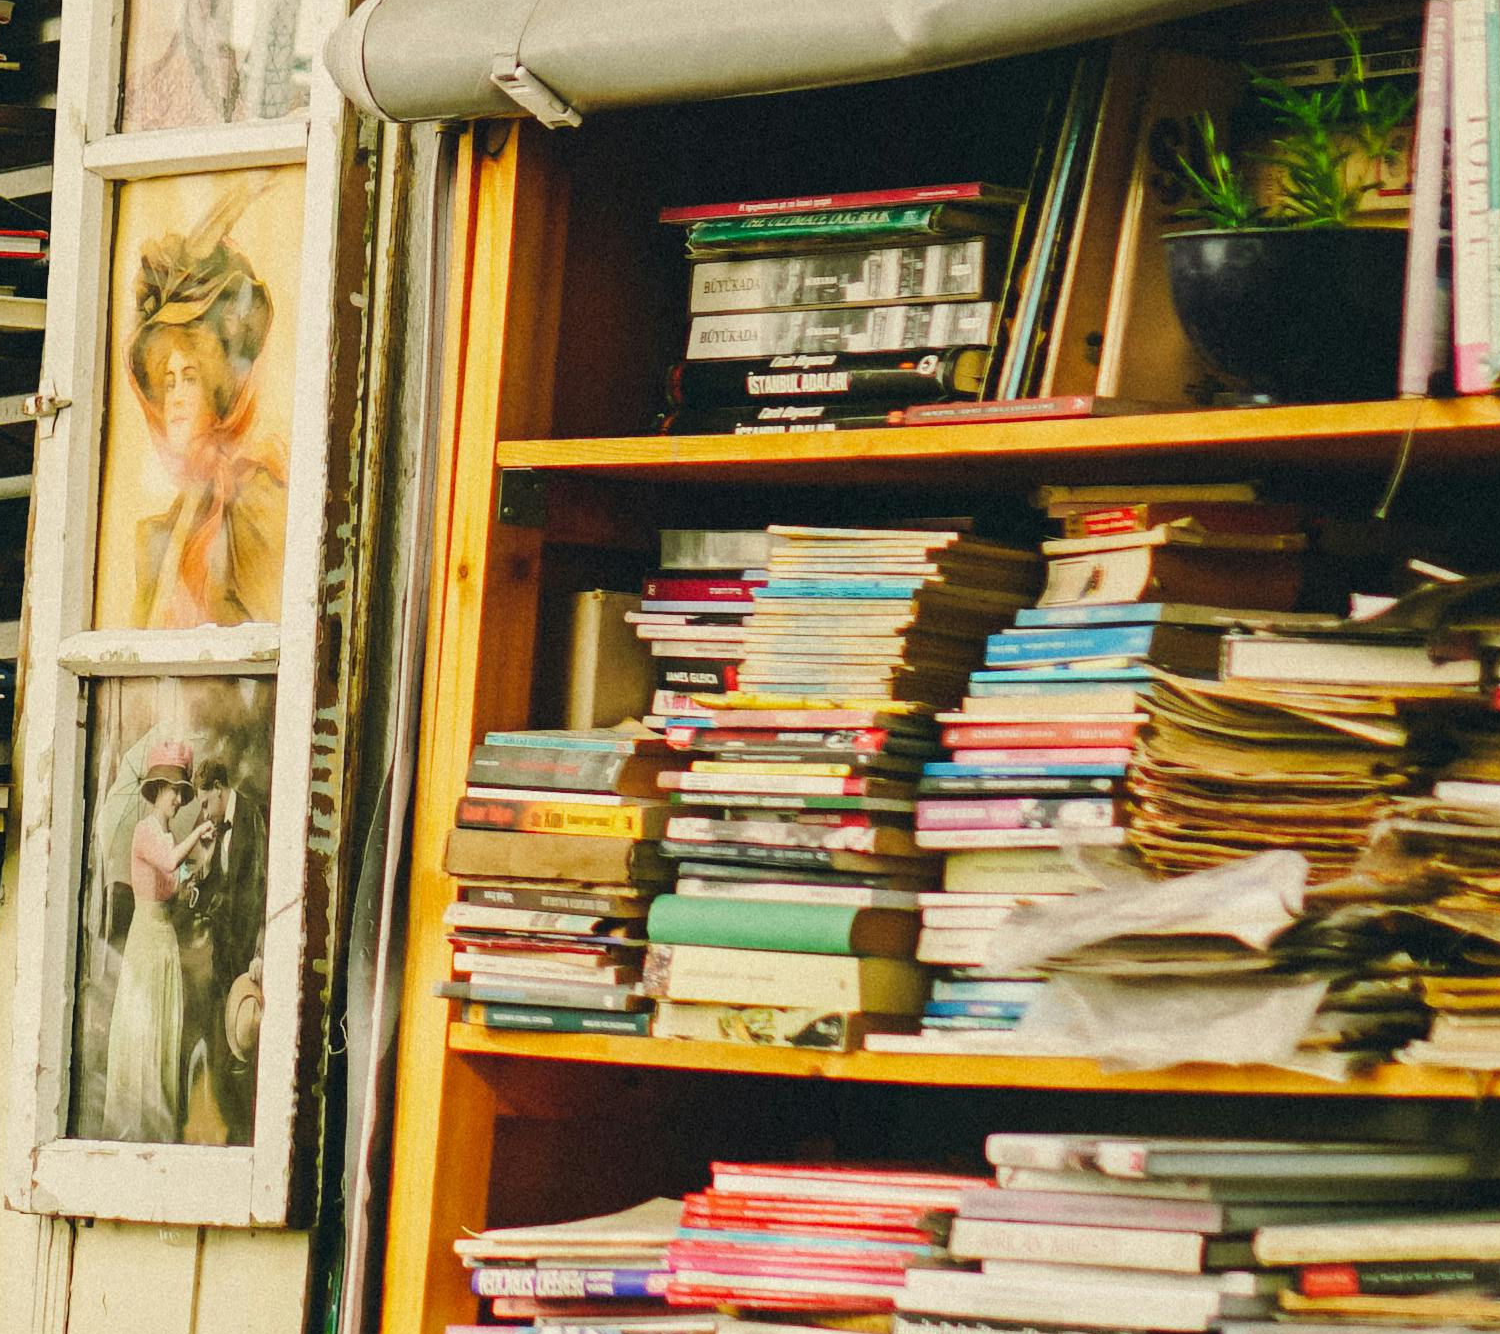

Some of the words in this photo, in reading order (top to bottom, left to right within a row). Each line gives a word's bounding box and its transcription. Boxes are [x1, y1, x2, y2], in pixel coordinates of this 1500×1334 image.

[703, 277, 761, 295] BÜYÜKADA
[699, 327, 759, 345] BÜYÜKADA
[746, 371, 801, 395] İSTANBUL
